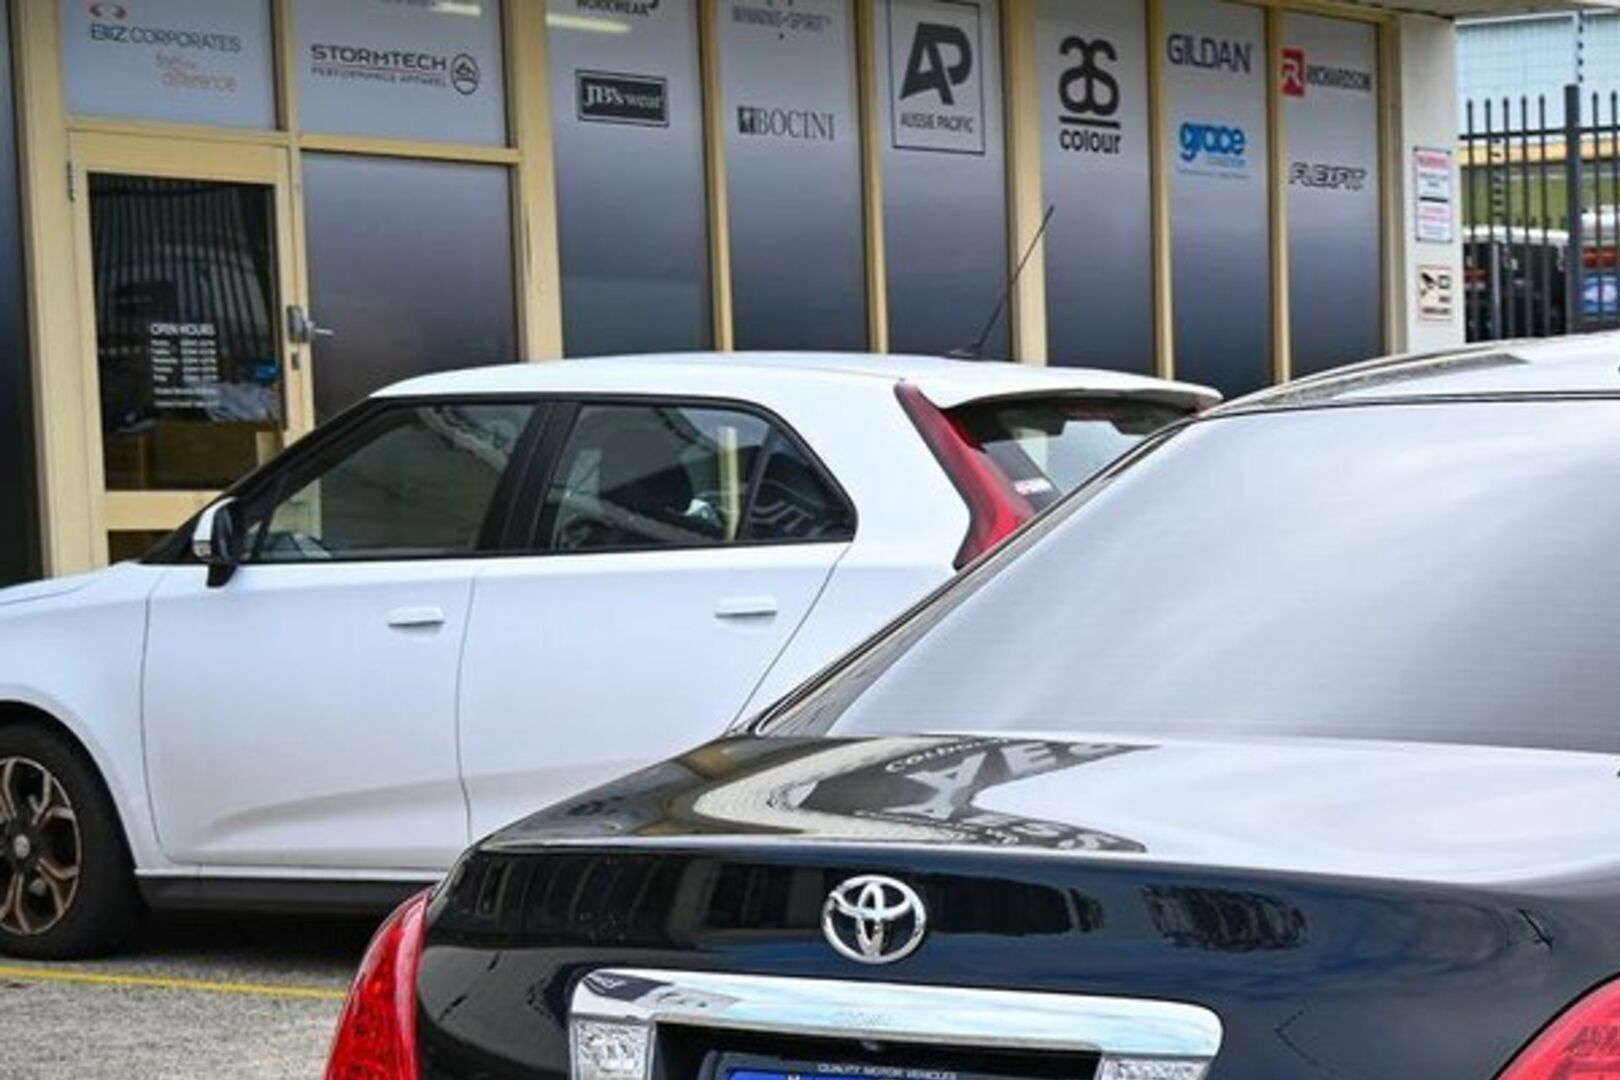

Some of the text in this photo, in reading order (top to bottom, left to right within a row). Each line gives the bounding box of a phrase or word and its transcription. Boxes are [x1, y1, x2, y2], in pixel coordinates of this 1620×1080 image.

[310, 44, 447, 70] STORMTECH
[1167, 34, 1252, 74] GILDAN
[756, 107, 835, 141] BOCINI
[1060, 129, 1121, 154] colour
[1180, 122, 1245, 162] grace
[817, 1062, 863, 1075] QUALITY
[864, 1064, 903, 1078] MOTOR
